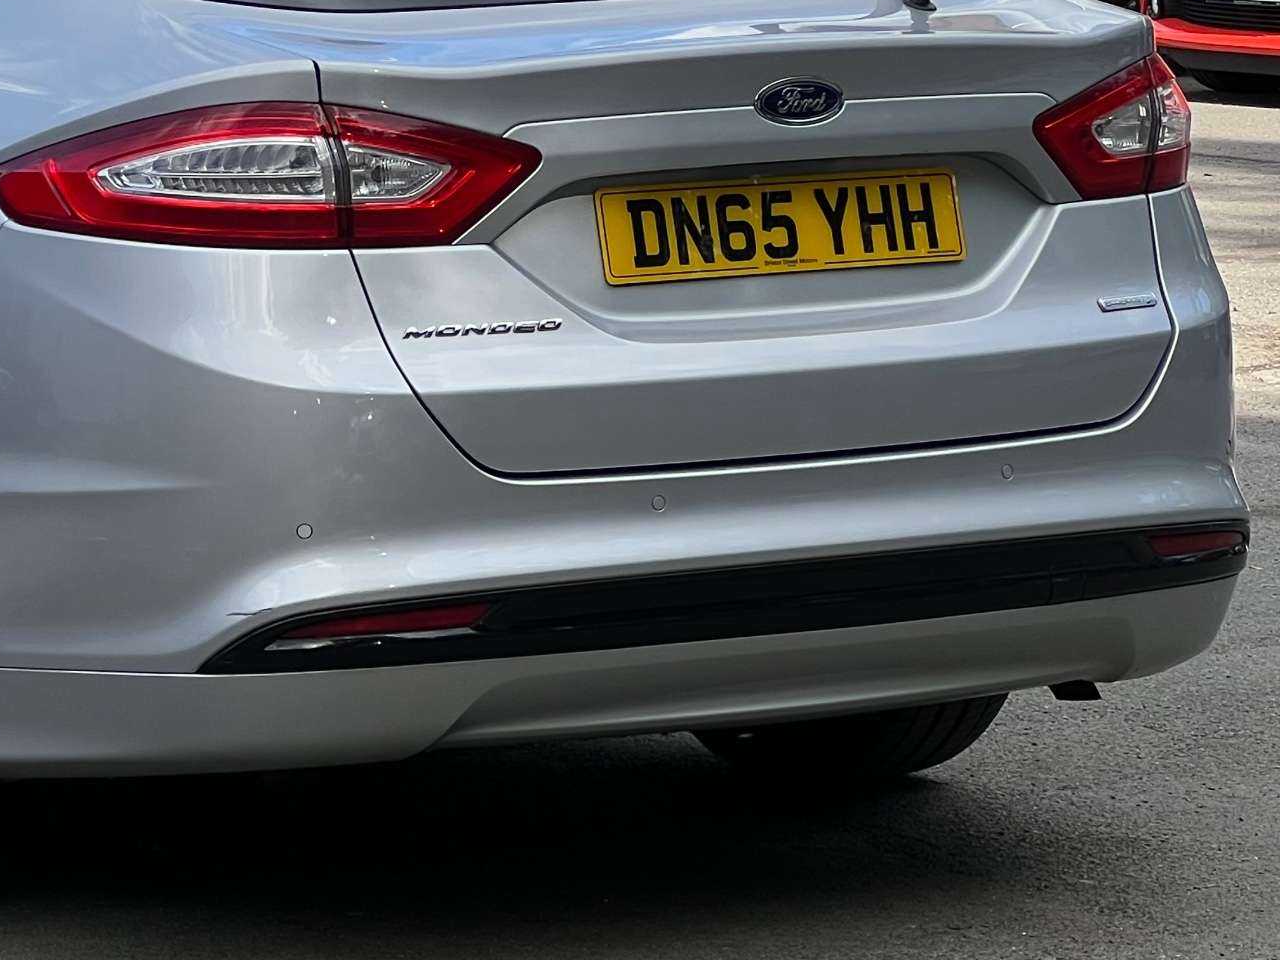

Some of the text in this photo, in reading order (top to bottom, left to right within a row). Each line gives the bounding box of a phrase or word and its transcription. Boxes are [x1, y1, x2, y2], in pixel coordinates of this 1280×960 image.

[777, 86, 827, 114] Ford
[626, 182, 939, 269] DN65 YHH
[402, 318, 564, 341] MONDEO
